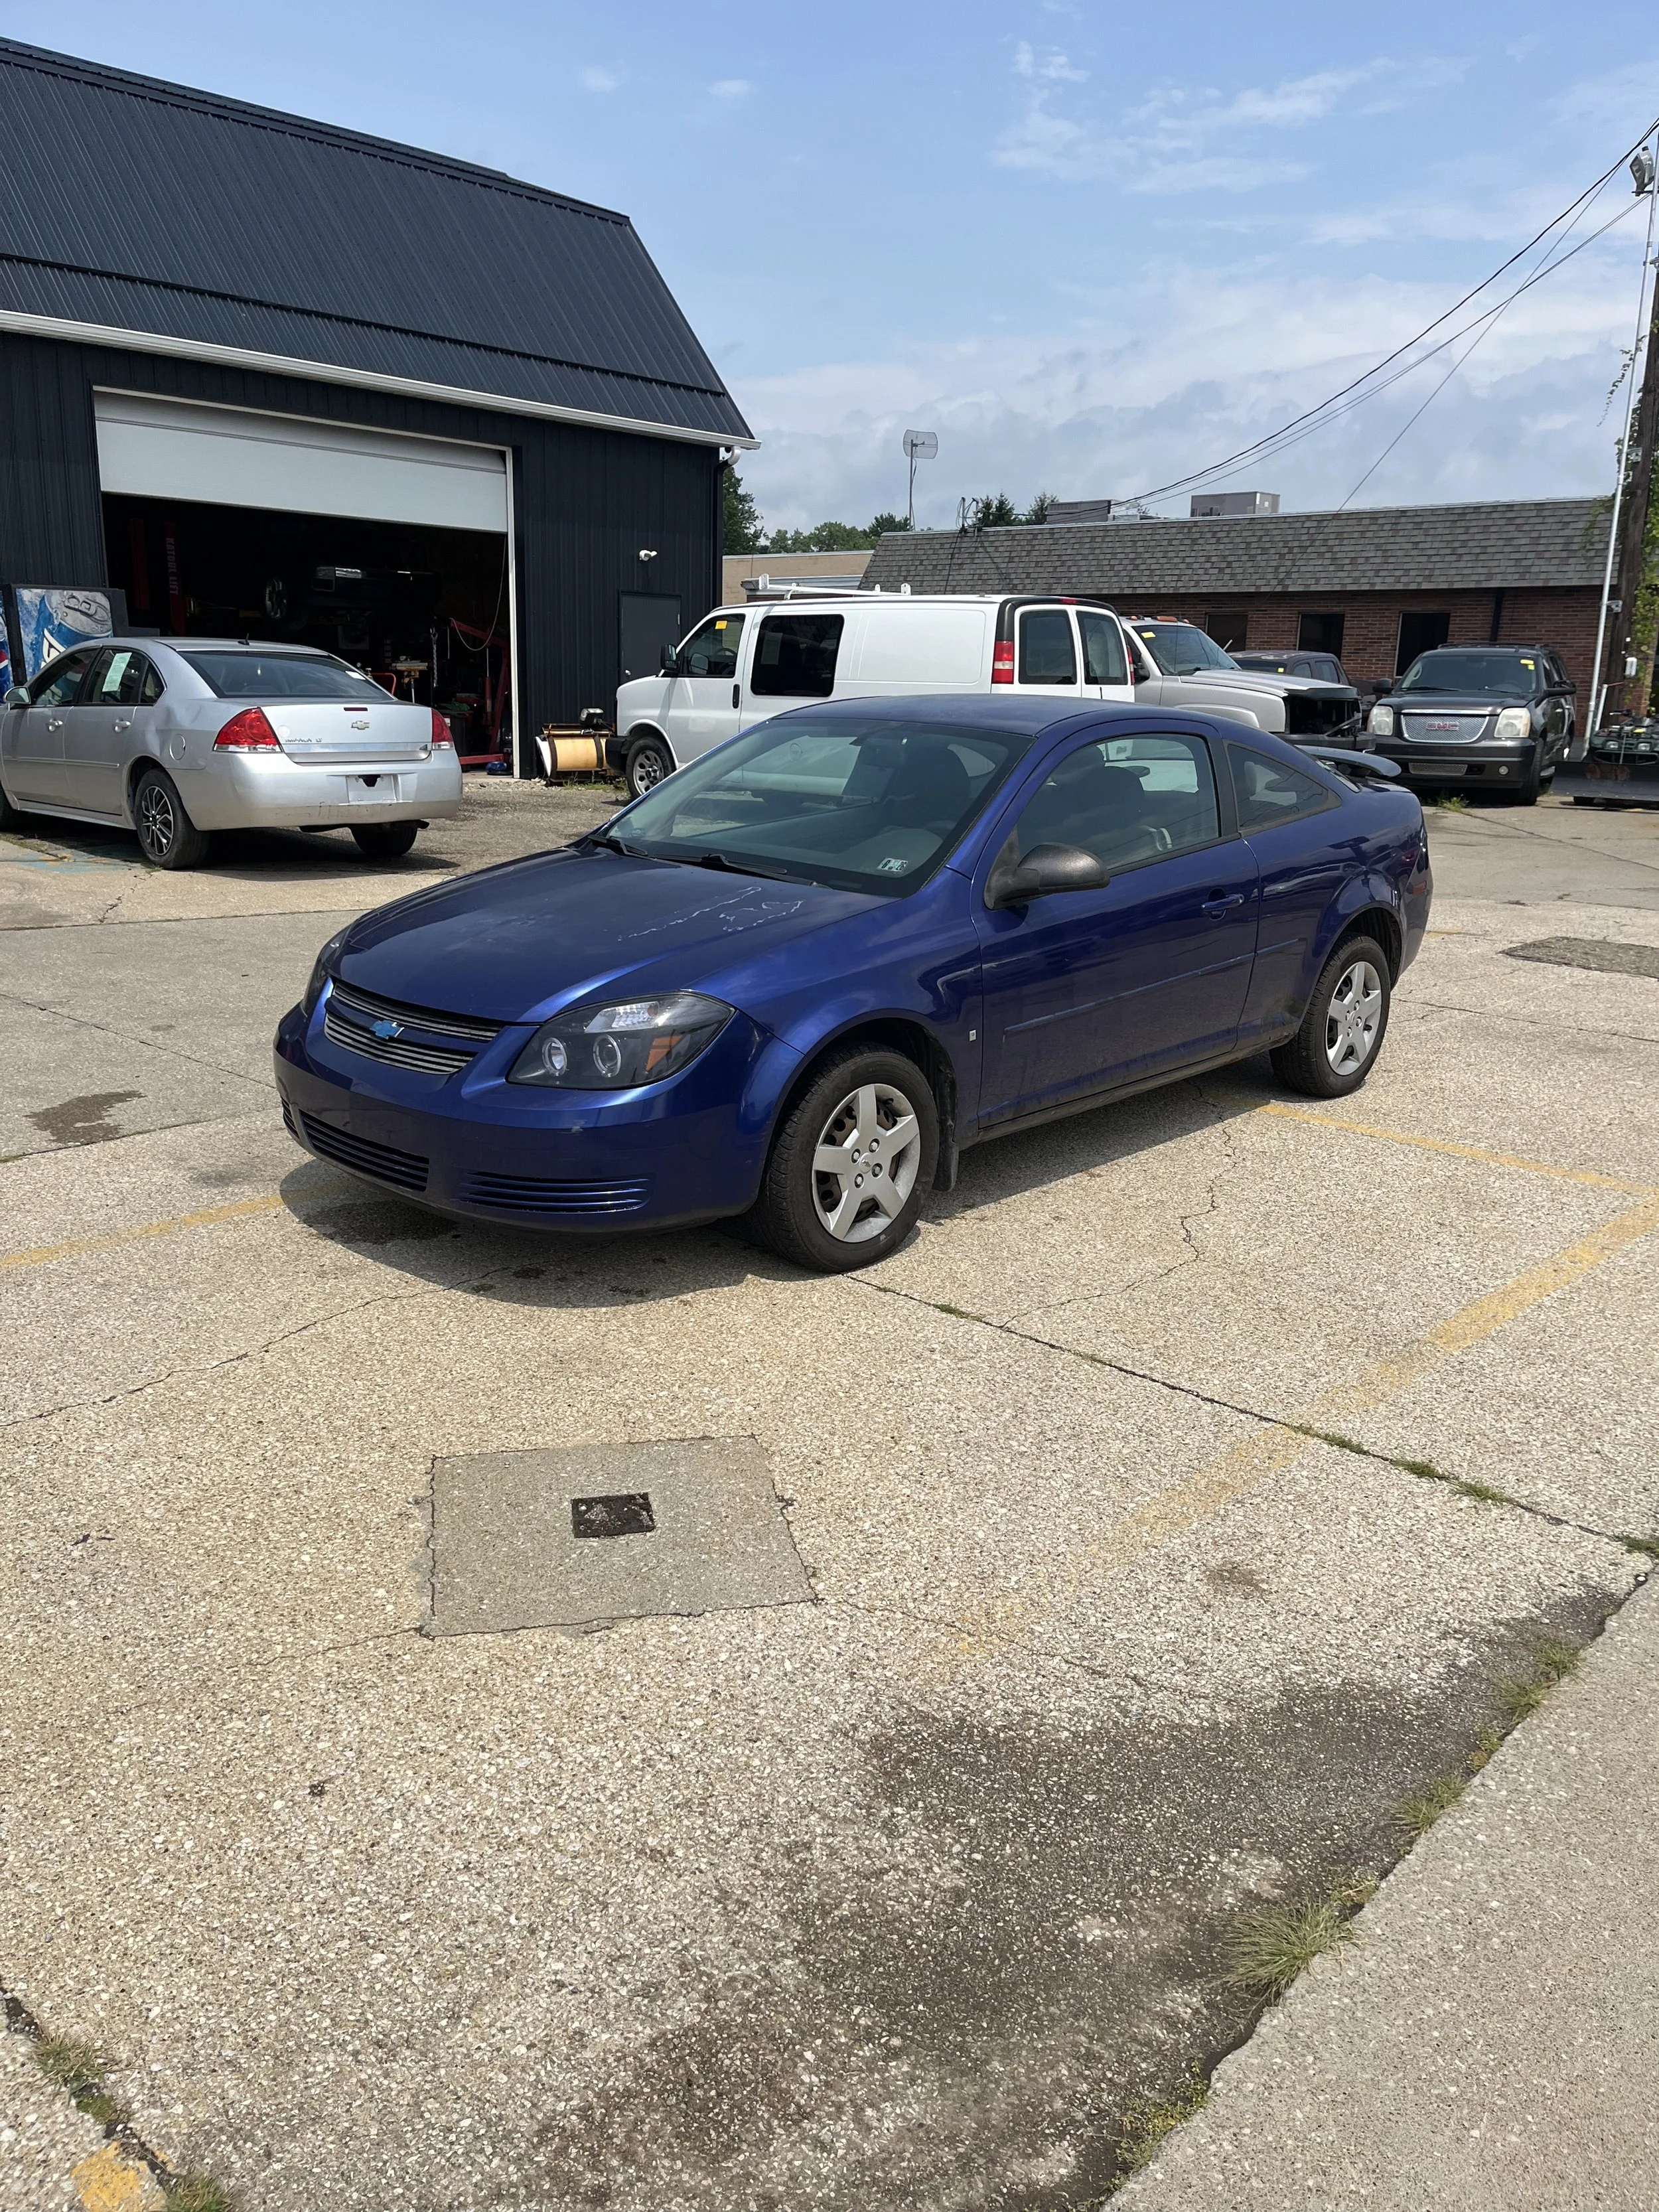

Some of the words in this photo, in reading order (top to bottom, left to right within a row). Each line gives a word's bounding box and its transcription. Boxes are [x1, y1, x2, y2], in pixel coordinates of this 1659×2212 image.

[169, 577, 179, 595] LIFT
[1426, 721, 1459, 730] GMC
[896, 861, 907, 870] 26
